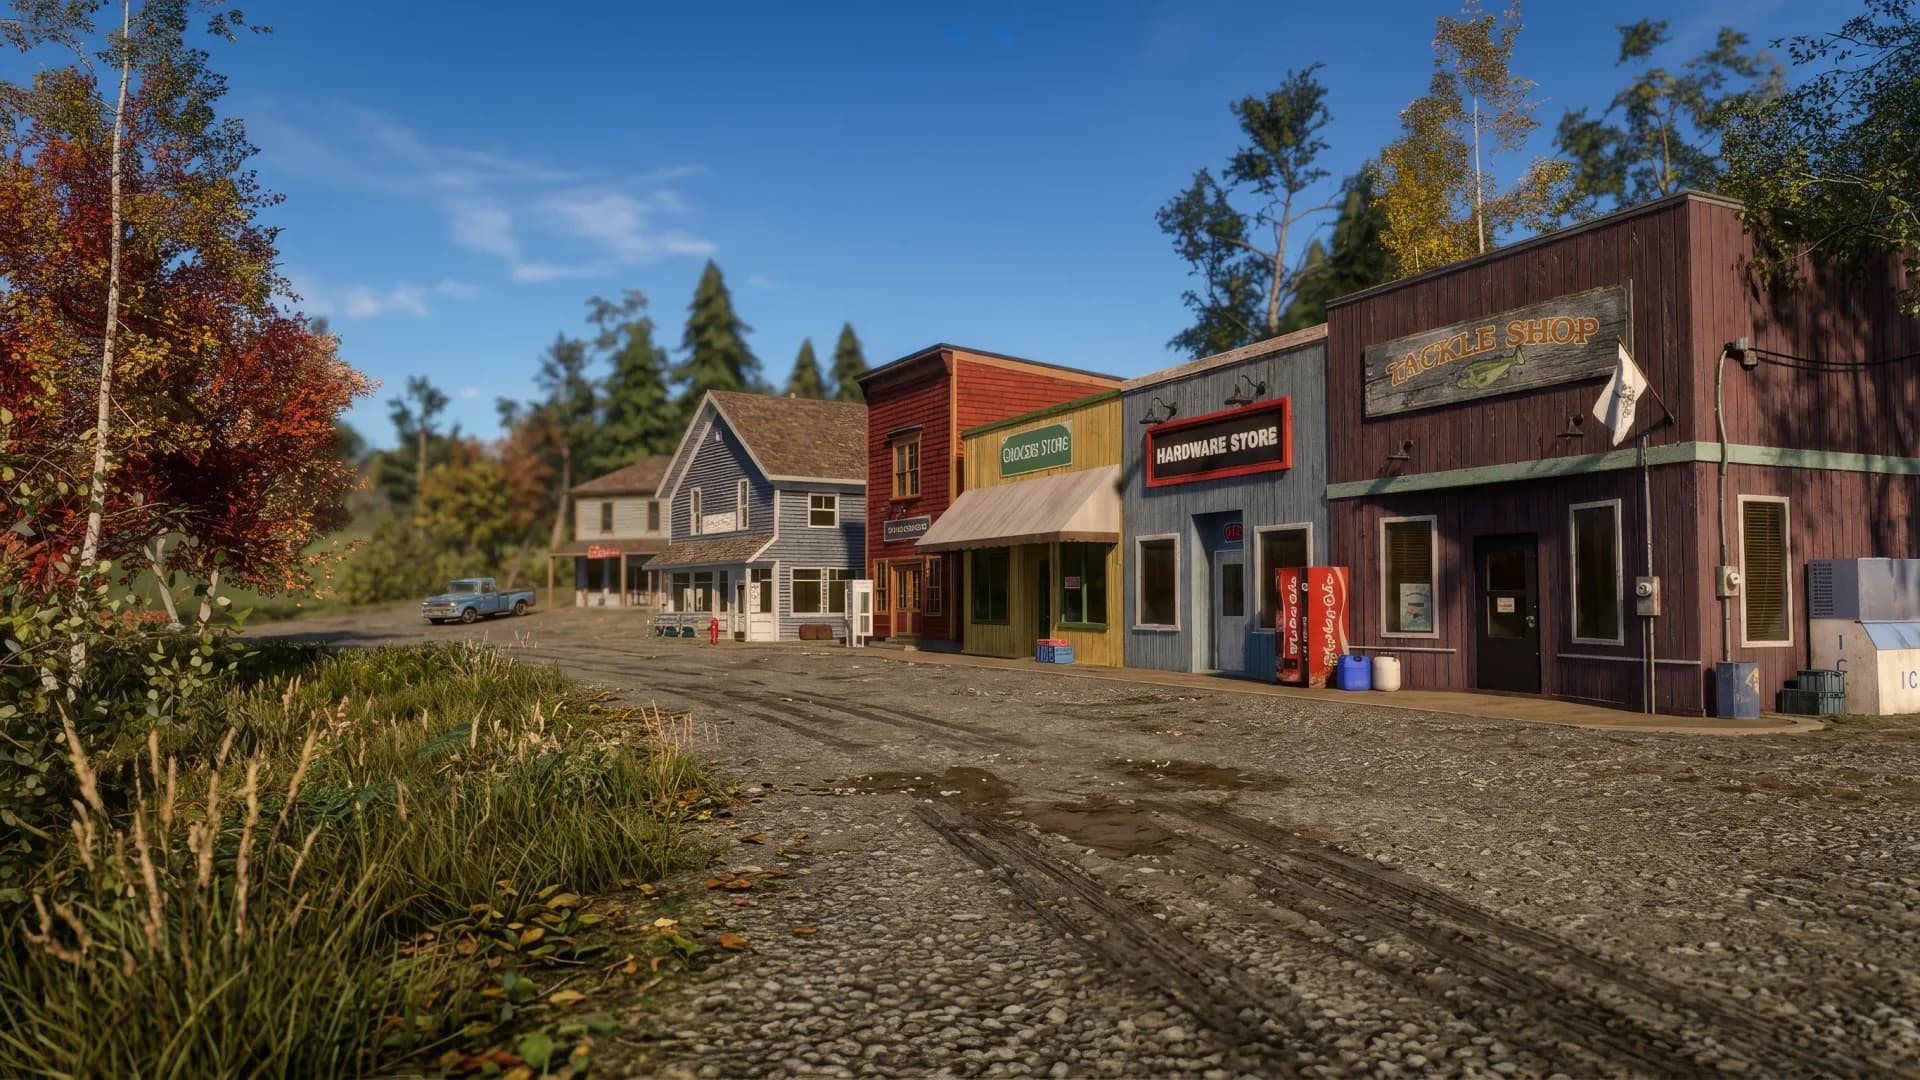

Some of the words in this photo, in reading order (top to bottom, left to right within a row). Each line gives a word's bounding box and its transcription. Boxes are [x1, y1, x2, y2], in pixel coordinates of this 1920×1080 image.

[1386, 324, 1496, 386] TACKLE
[1505, 316, 1599, 347] SHOP
[1156, 435, 1227, 465] HARDWARE
[1230, 426, 1278, 452] STORE
